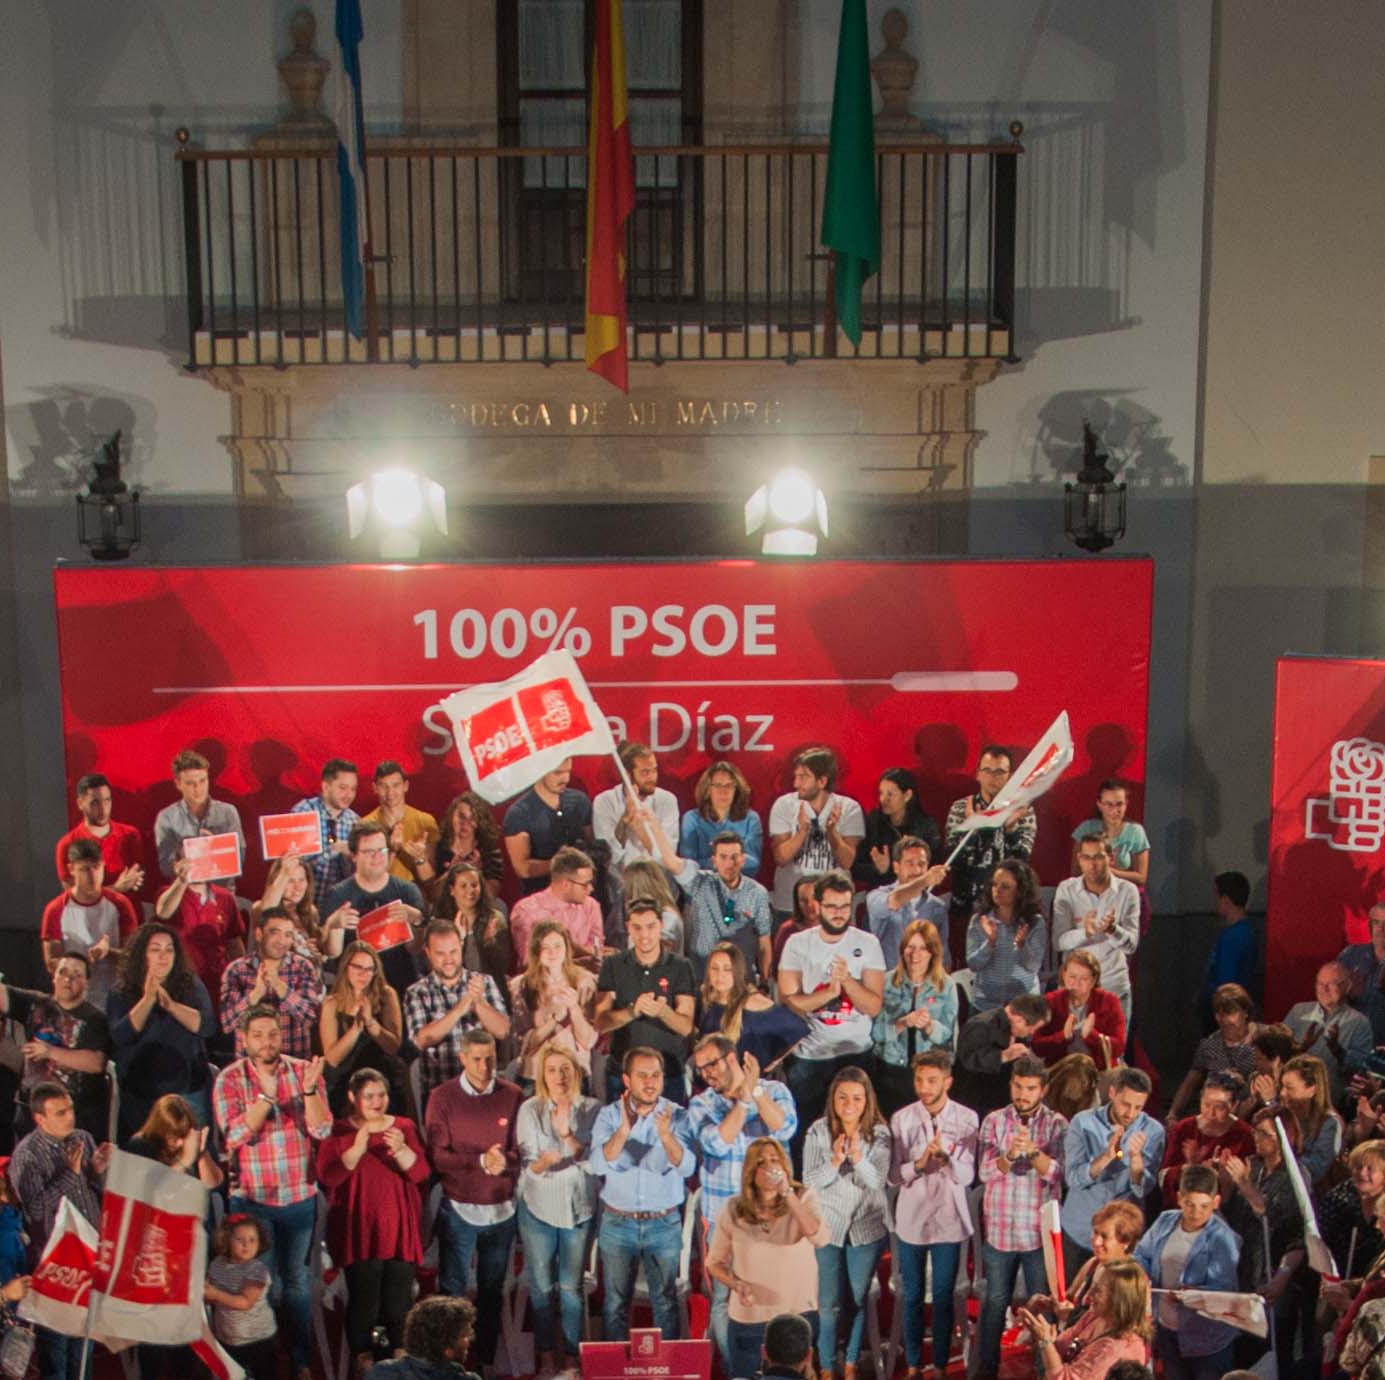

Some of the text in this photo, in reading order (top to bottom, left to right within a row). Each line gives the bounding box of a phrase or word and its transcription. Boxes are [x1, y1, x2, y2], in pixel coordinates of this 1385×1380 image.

[569, 401, 607, 426] DE
[628, 401, 657, 426] MI
[413, 604, 777, 660] 100% PSOE
[474, 724, 524, 767] PSOE
[650, 700, 775, 752] Díaz
[648, 1366, 670, 1375] PSOE
